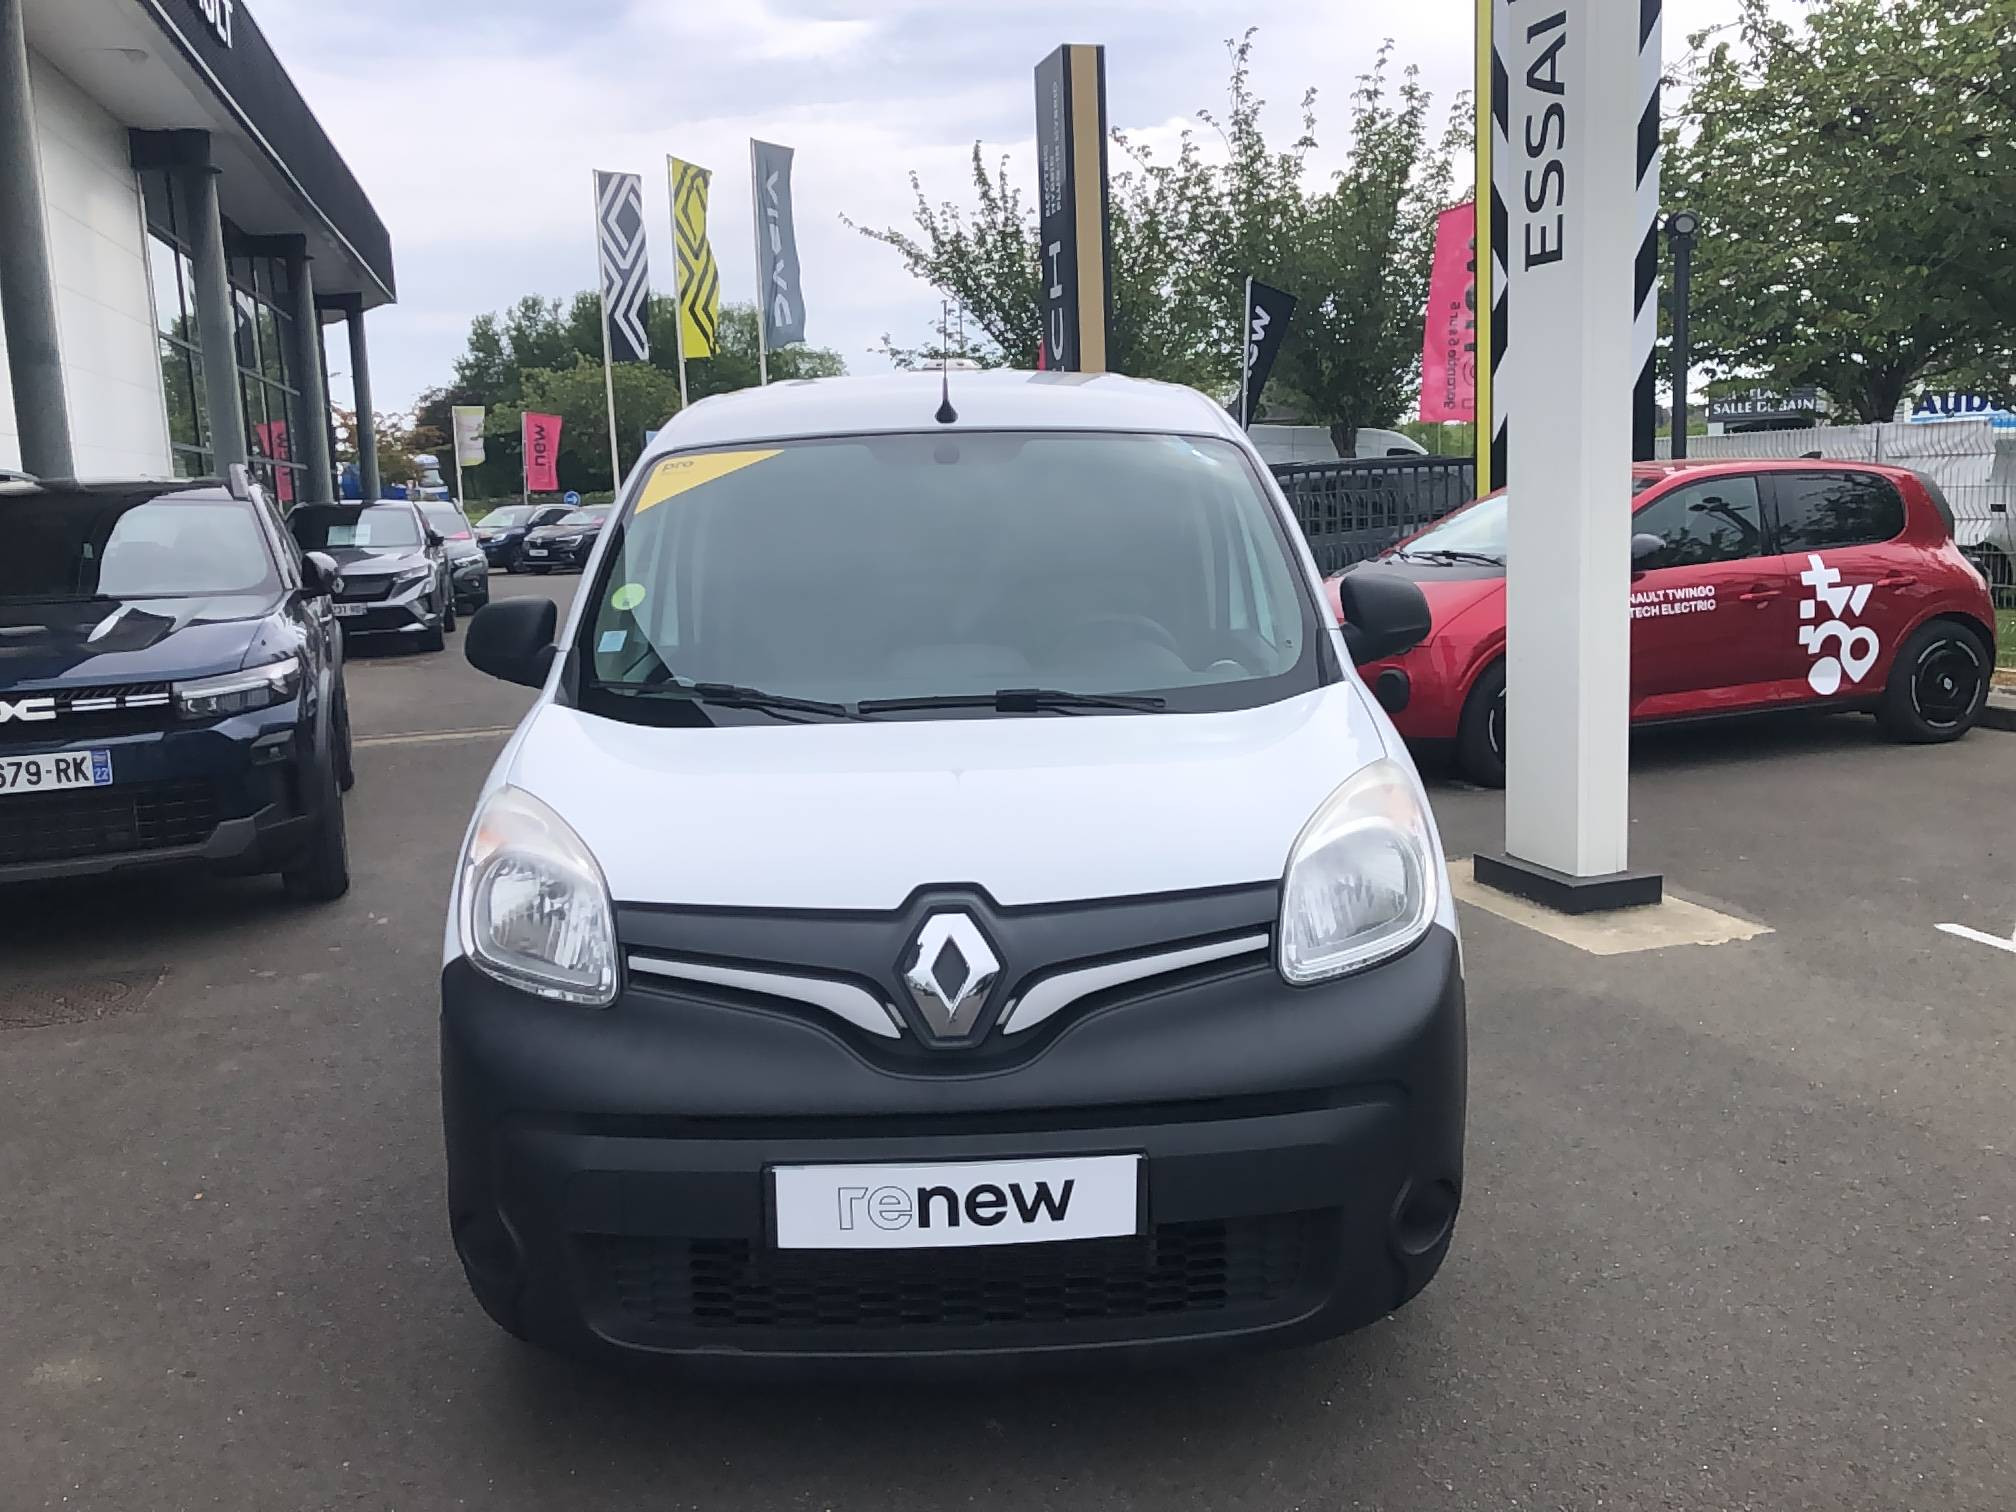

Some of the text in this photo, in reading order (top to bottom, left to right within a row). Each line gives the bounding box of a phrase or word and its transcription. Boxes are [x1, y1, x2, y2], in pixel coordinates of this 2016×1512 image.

[1713, 401, 1752, 415] SALLE
[1630, 585, 1715, 604] NAULT TWINGO
[1630, 599, 1716, 618] TECH ELECTRIC
[838, 1179, 1075, 1230] renew
